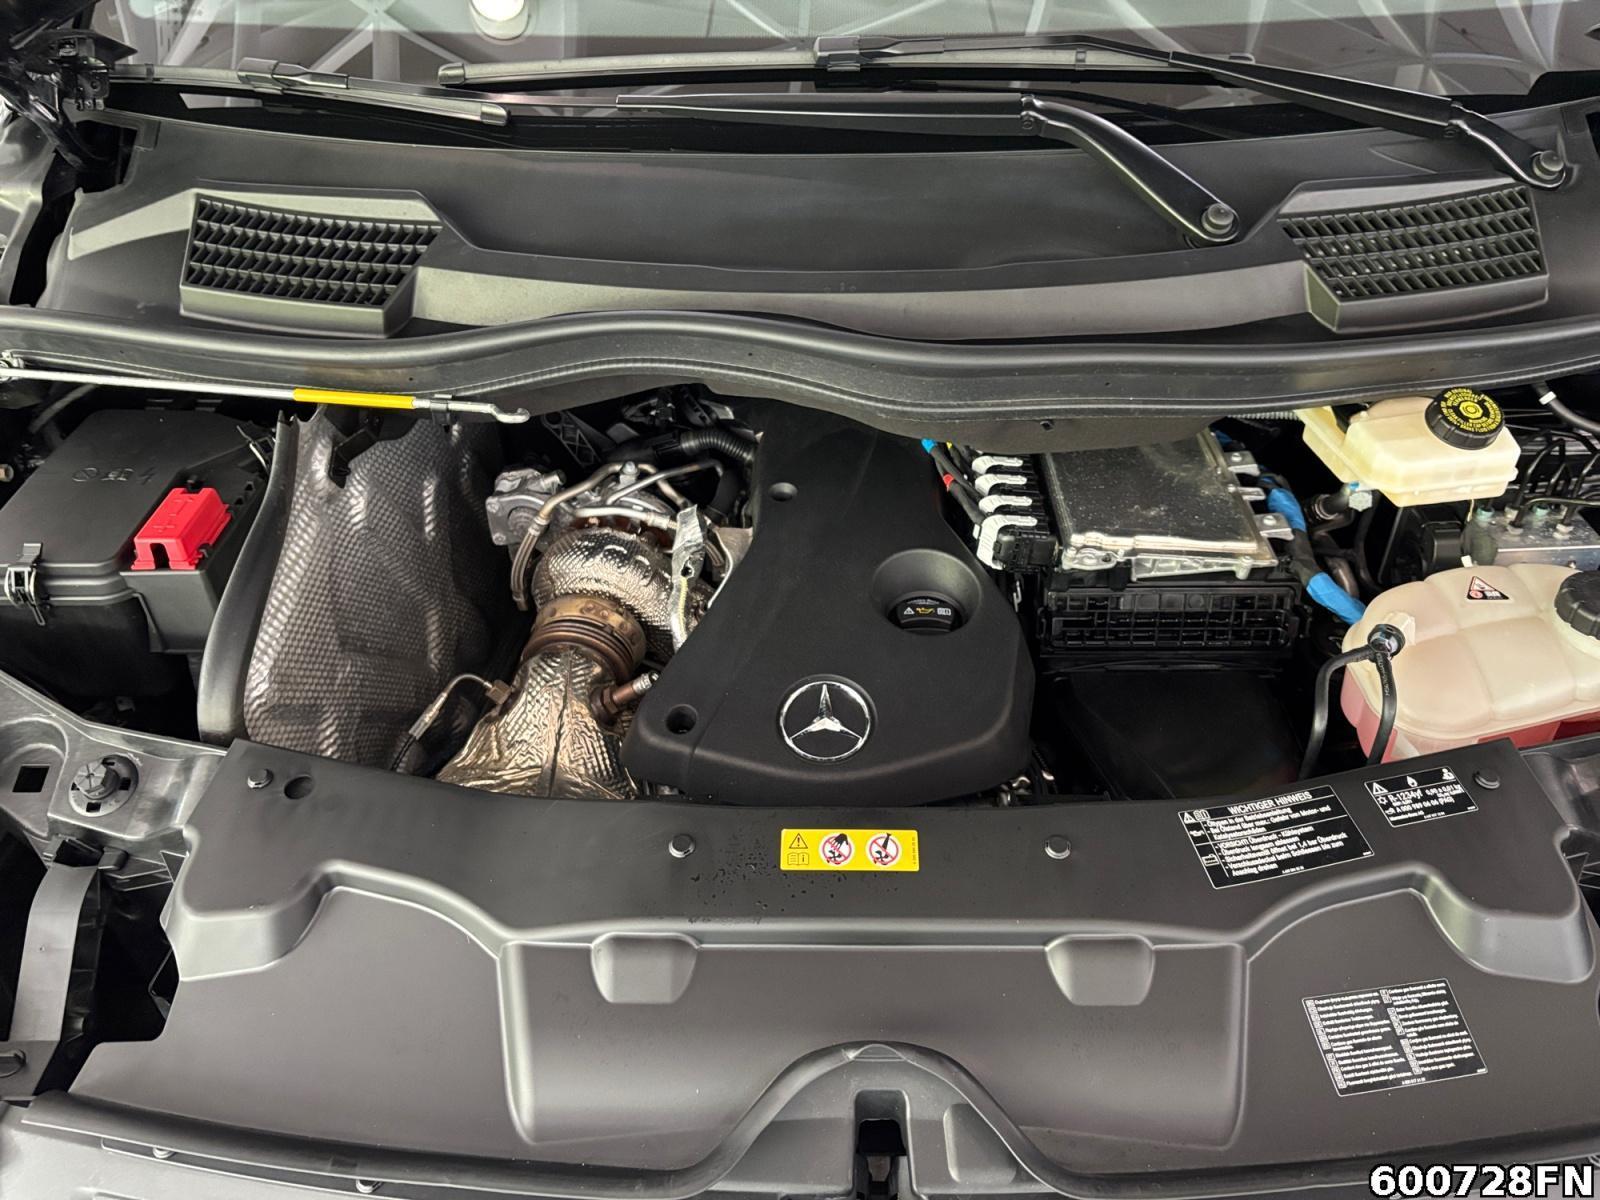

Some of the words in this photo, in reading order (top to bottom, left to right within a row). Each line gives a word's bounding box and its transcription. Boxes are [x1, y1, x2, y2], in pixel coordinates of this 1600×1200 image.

[1227, 800, 1276, 814] WICHTIGER
[1274, 792, 1312, 805] HINWEIS
[1388, 789, 1423, 803] R-1234yf
